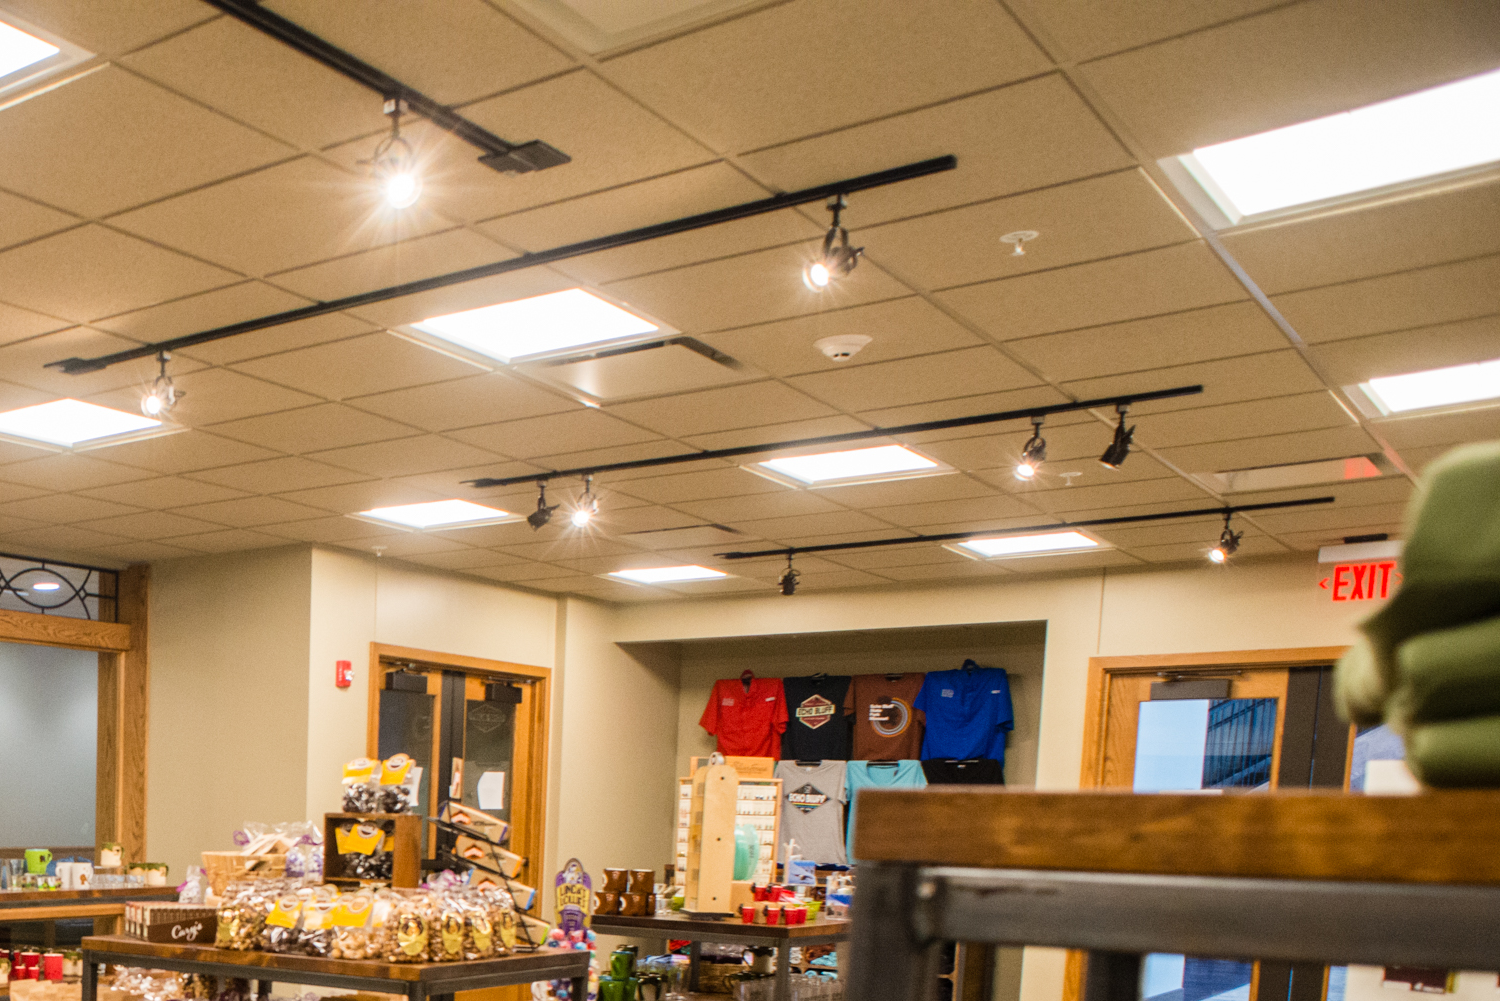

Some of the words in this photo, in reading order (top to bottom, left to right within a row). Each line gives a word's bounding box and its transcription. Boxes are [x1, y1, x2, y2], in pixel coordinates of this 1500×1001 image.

[1332, 561, 1397, 602] EXIT
[798, 707, 813, 716] ECHO
[815, 705, 833, 714] BLUFF
[788, 793, 805, 803] ECHO
[806, 793, 828, 804] BLUFF
